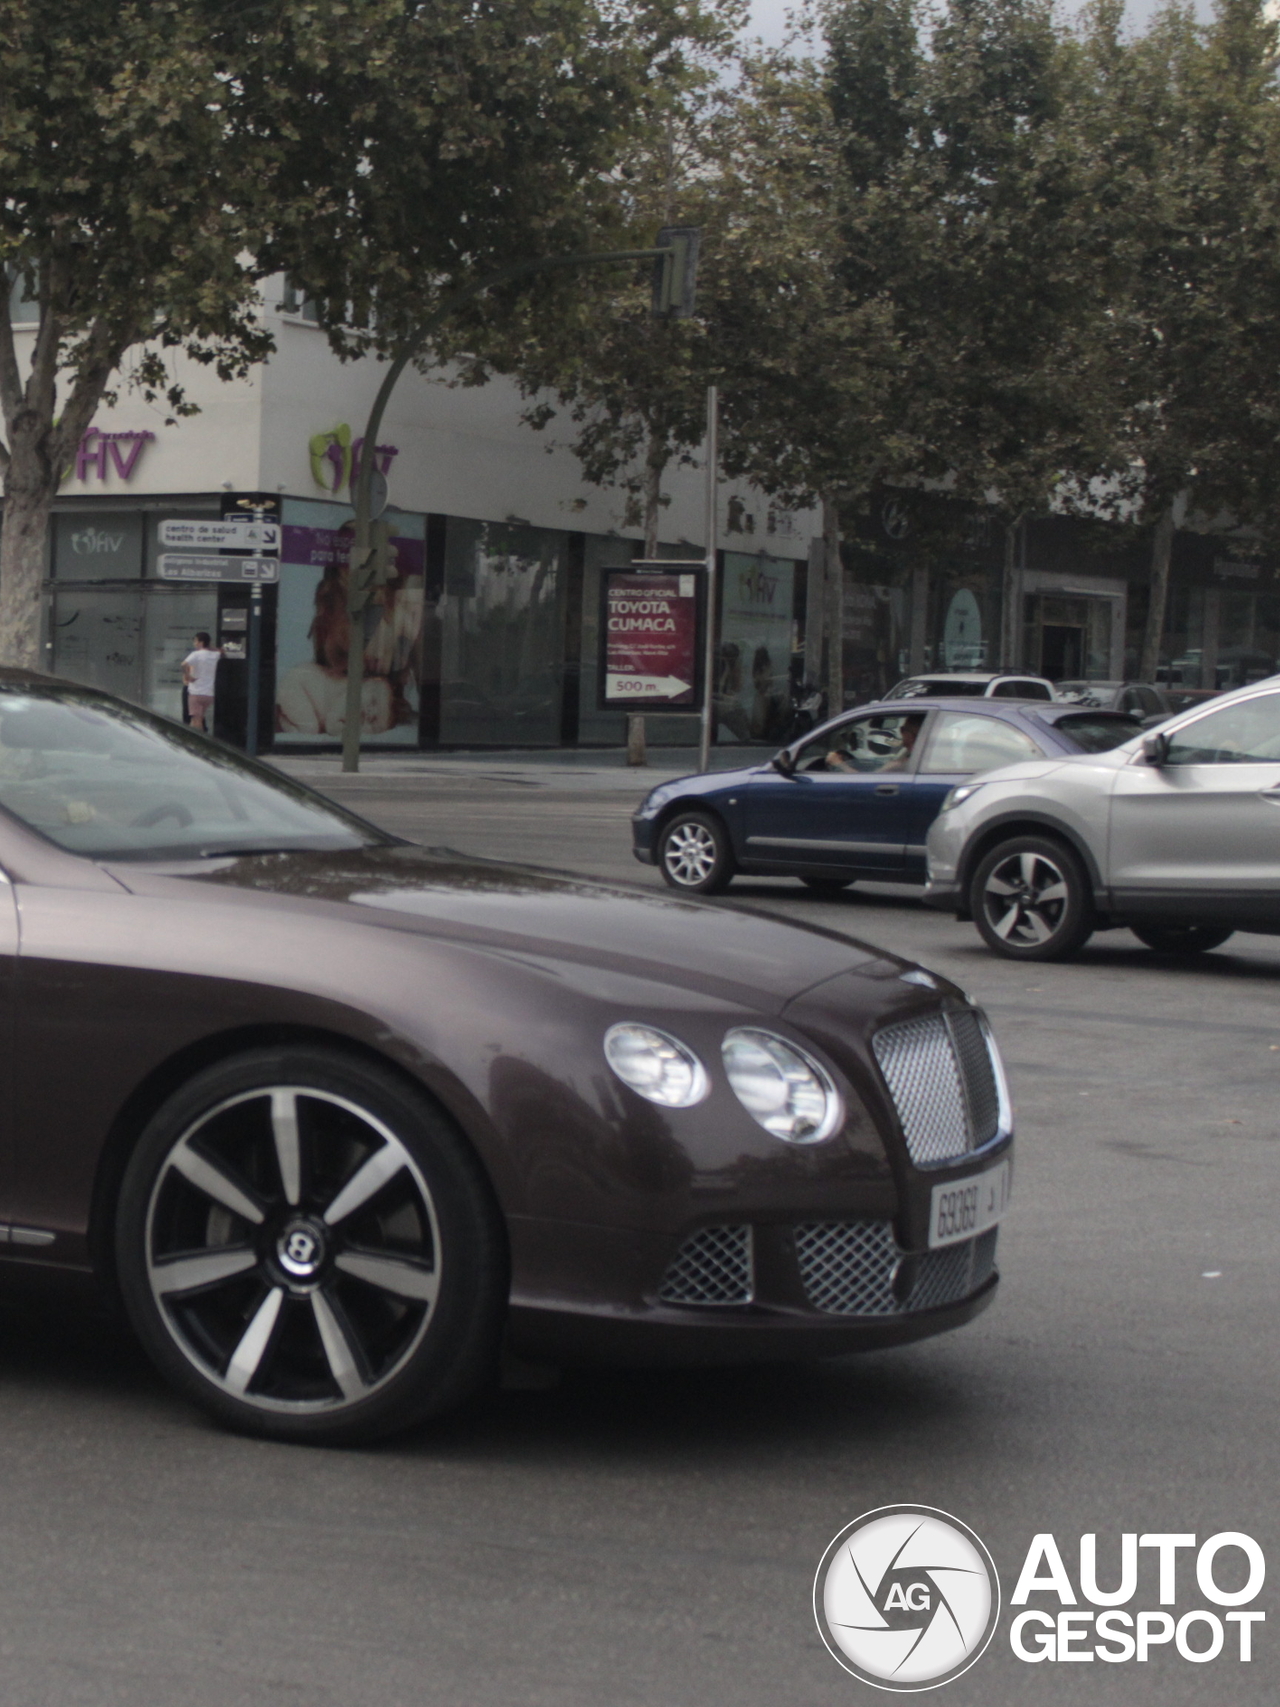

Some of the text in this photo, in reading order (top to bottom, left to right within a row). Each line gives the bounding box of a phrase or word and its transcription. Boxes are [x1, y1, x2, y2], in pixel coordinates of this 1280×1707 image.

[165, 525, 237, 534] centro de salud
[165, 533, 226, 543] health center
[608, 589, 677, 597] CENTRO OFICIAL
[608, 600, 671, 614] TOYOTA
[607, 617, 676, 632] CUMACA
[616, 681, 643, 692] 500
